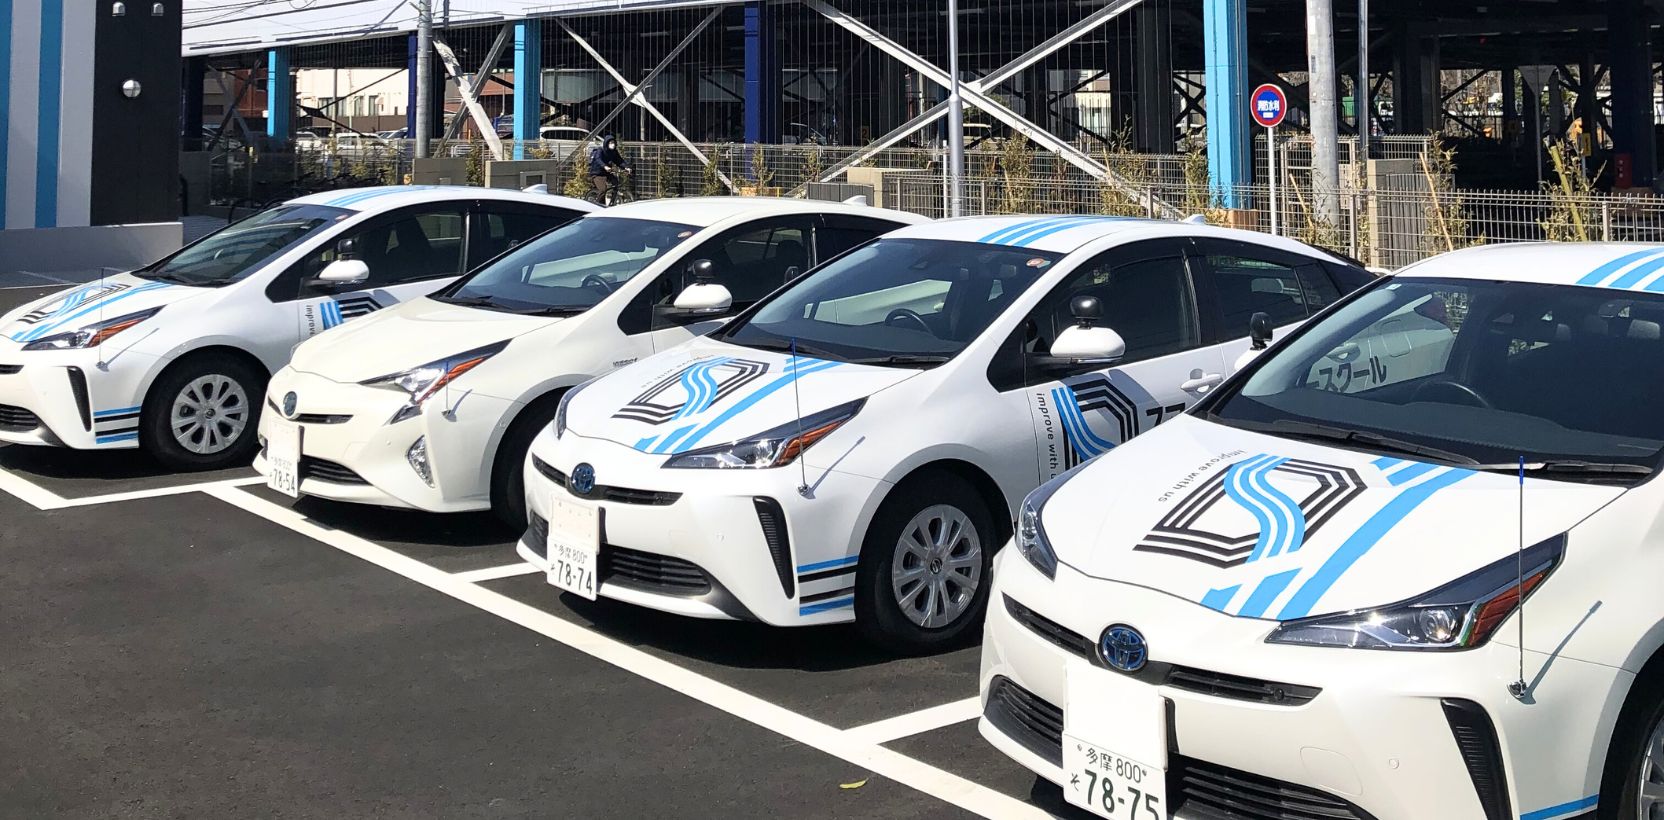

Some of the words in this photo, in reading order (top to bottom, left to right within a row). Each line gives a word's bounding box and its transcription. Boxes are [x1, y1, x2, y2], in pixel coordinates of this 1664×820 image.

[1036, 392, 1055, 440] improve
[1048, 444, 1059, 469] with
[1158, 491, 1175, 503] us
[1172, 472, 1200, 490] with
[557, 559, 593, 595] 78-74
[1086, 747, 1113, 771] 多摩
[1116, 758, 1141, 783] 800
[1084, 768, 1160, 820] 78-75
